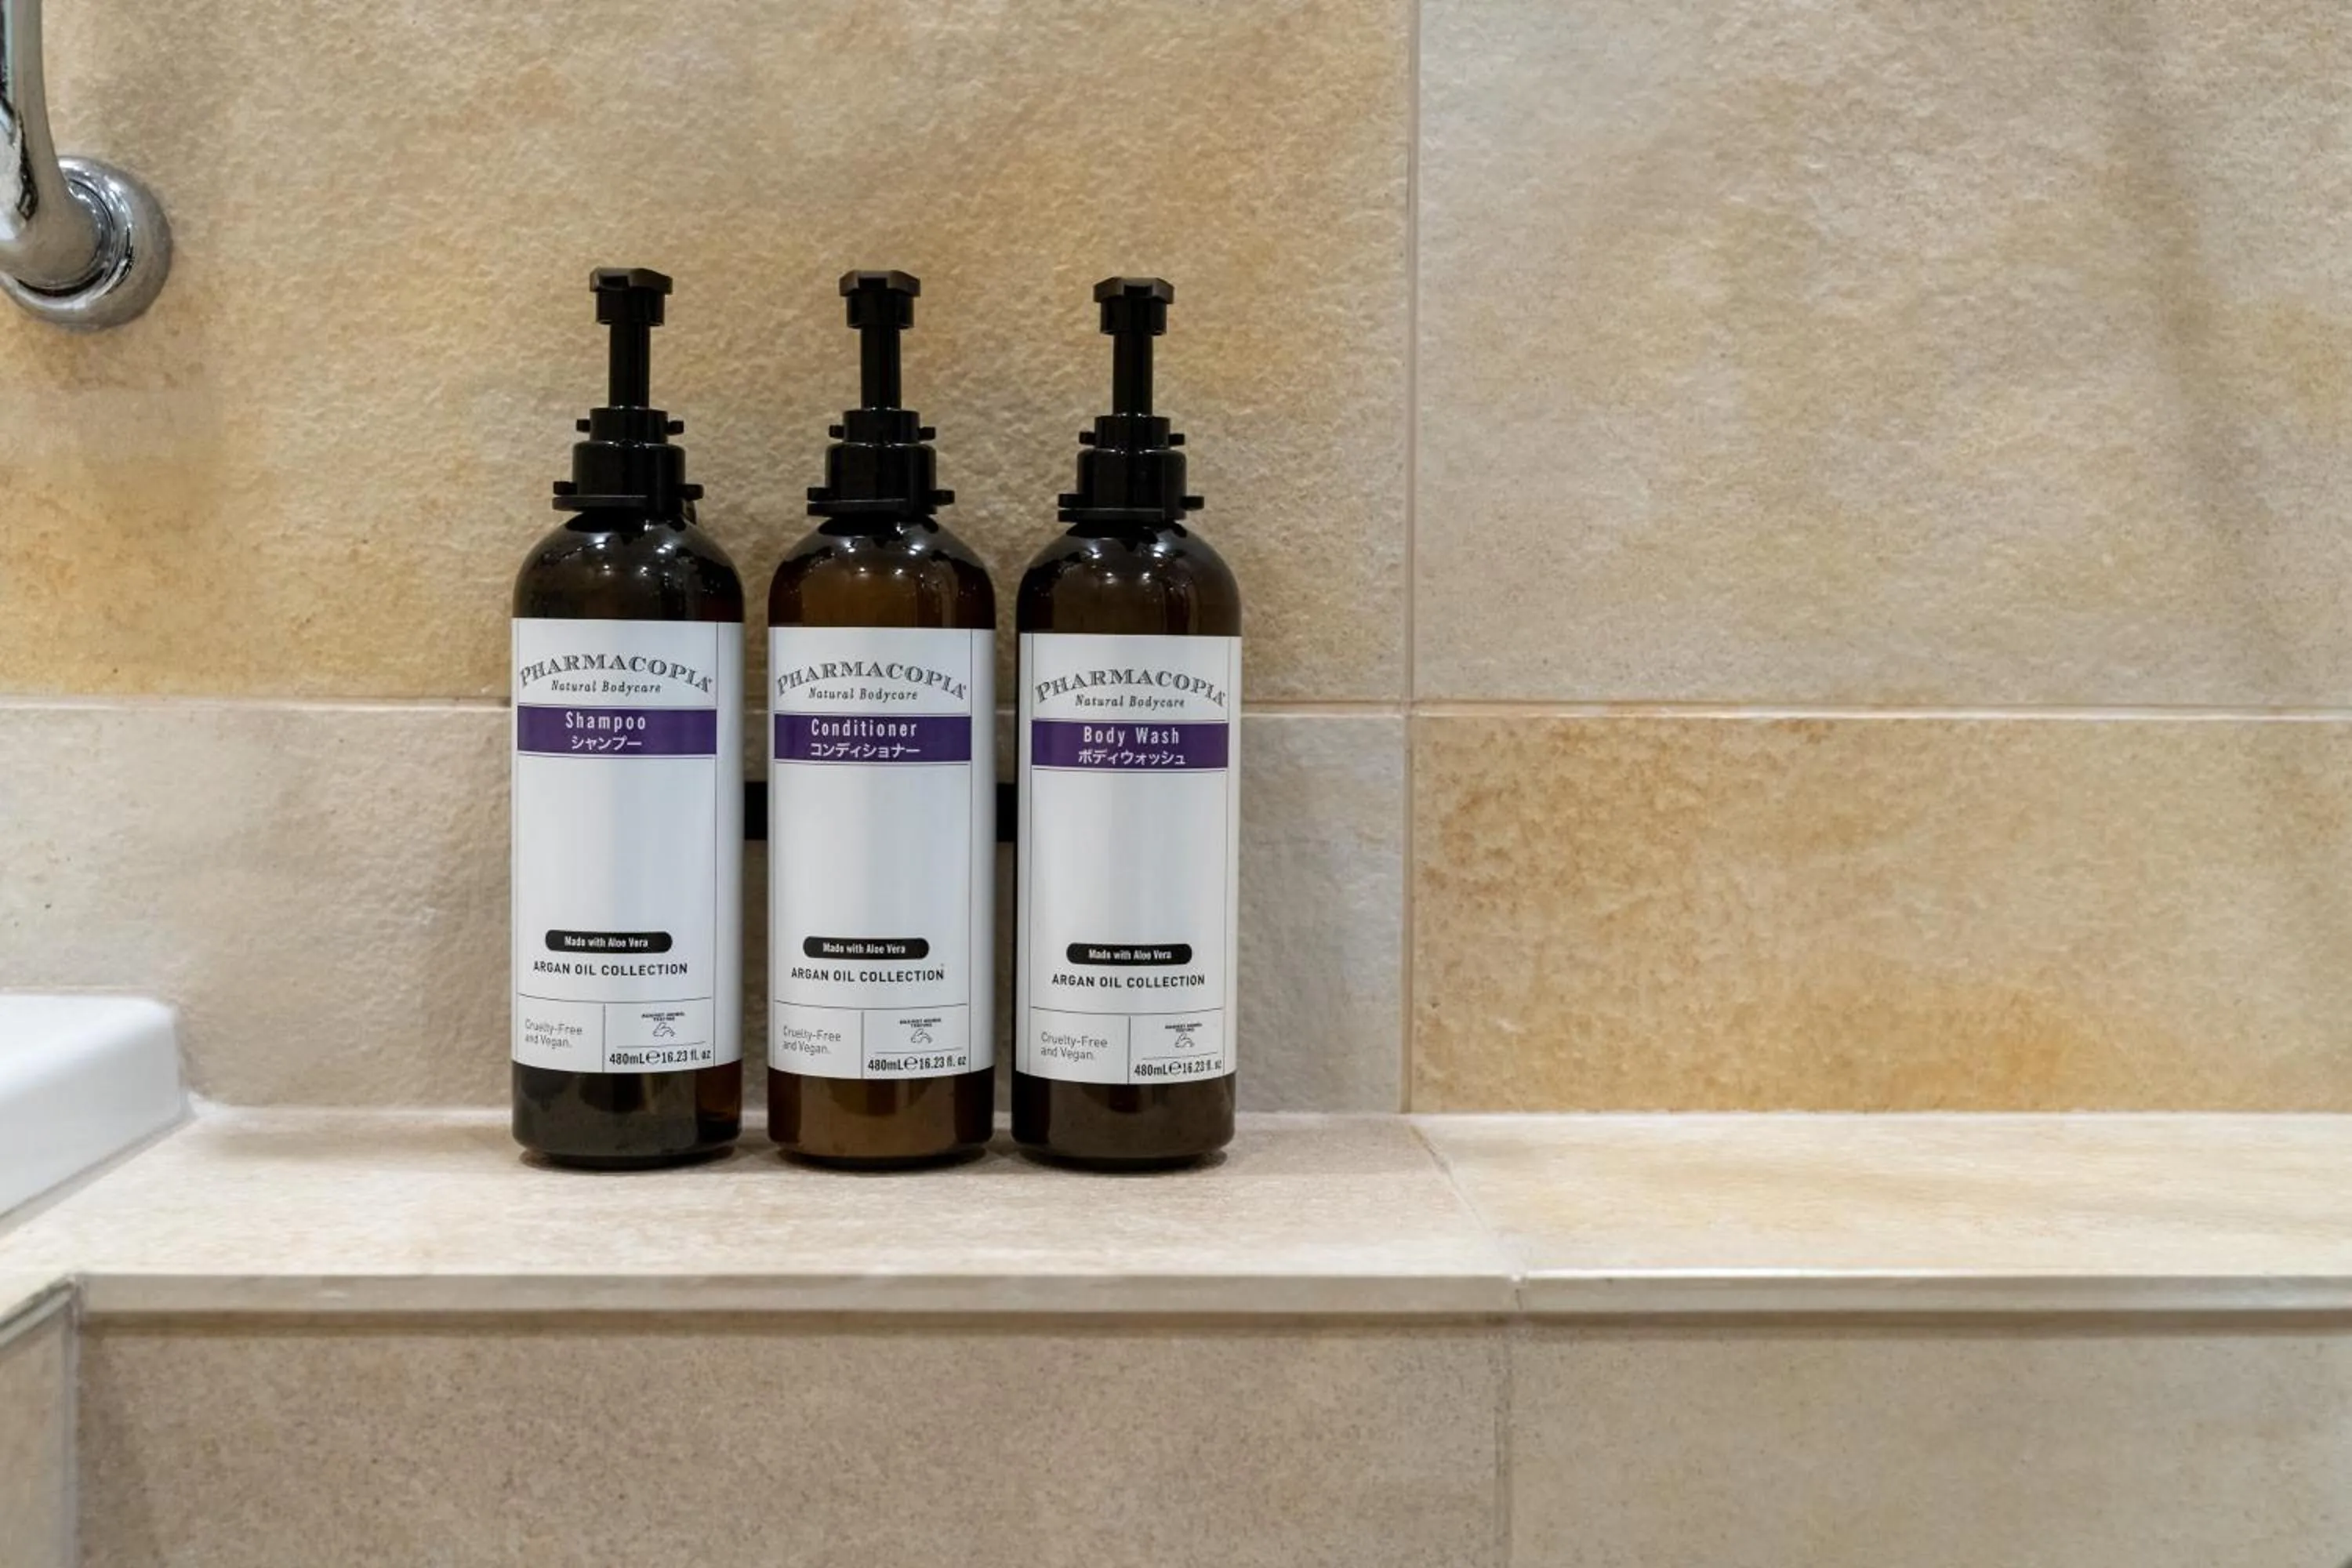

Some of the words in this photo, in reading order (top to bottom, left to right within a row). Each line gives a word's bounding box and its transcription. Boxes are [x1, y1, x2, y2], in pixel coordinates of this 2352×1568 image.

[520, 654, 710, 692] PHARMACOPIA
[777, 661, 964, 700] PHARMACOPIA
[551, 680, 597, 692] Natural
[602, 681, 661, 696] Bodycare
[808, 688, 854, 699] Natural
[859, 688, 918, 702] Bodycare
[1035, 668, 1225, 706] PHARMACOPIA
[1075, 695, 1123, 707] Natural
[1129, 695, 1185, 711] Bodycare
[565, 711, 646, 732] Shampoo
[811, 718, 916, 736] Conditioner
[572, 735, 642, 750] シャンプー
[1083, 726, 1126, 747] Body
[1135, 728, 1180, 744] Wash
[810, 742, 920, 758] コンディショナー
[1078, 749, 1186, 765] ボディウォッシュ
[564, 935, 586, 947] Made
[588, 937, 605, 947] with
[608, 938, 626, 948] Aloe
[628, 938, 648, 948] Vera
[823, 942, 844, 953] Made
[846, 943, 864, 953] with
[866, 944, 884, 954] Aloe
[887, 944, 906, 954] Vera
[1088, 949, 1111, 960] Made
[1113, 949, 1131, 960] with
[1133, 950, 1152, 960] Aloe
[1153, 949, 1171, 960] Vera
[533, 961, 570, 975] ARGAN
[575, 964, 596, 975] OIL
[601, 963, 688, 976] COLLECTION
[791, 967, 829, 981] ARGAN
[833, 971, 855, 982] OIL
[859, 969, 944, 982] COLLECTION
[1051, 974, 1095, 987] ARGAN
[1100, 977, 1122, 988] OIL
[1127, 975, 1206, 988] COLLECTION
[524, 1018, 583, 1036] Cruelty-Free
[783, 1025, 841, 1042] Cruelty-Free
[524, 1034, 538, 1044] and
[782, 1041, 797, 1051] and
[1040, 1031, 1108, 1048] Cruelty-Free
[1040, 1047, 1058, 1058] and
